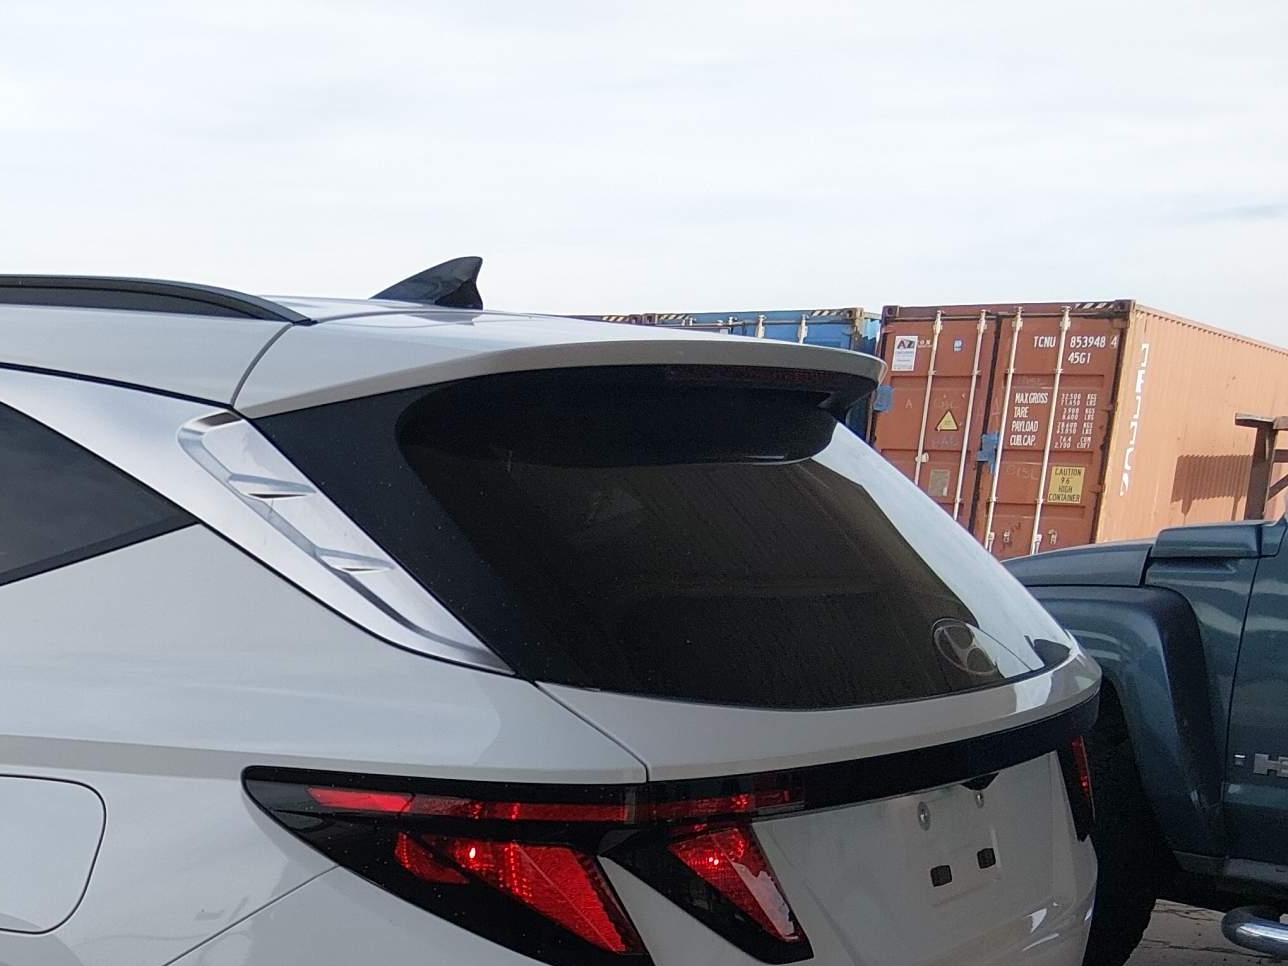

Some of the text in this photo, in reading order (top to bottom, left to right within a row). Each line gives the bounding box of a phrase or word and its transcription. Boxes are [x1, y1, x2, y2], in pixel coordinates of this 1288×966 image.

[1033, 335, 1056, 348] TCNU
[1069, 335, 1106, 348] 853948
[1068, 352, 1091, 364] 45G1
[1013, 406, 1029, 418] TARE
[1011, 420, 1039, 432] PAYLOAD
[1054, 467, 1081, 476] CAUTION
[1058, 485, 1073, 493] HIGH
[1048, 493, 1080, 502] CONTAINER
